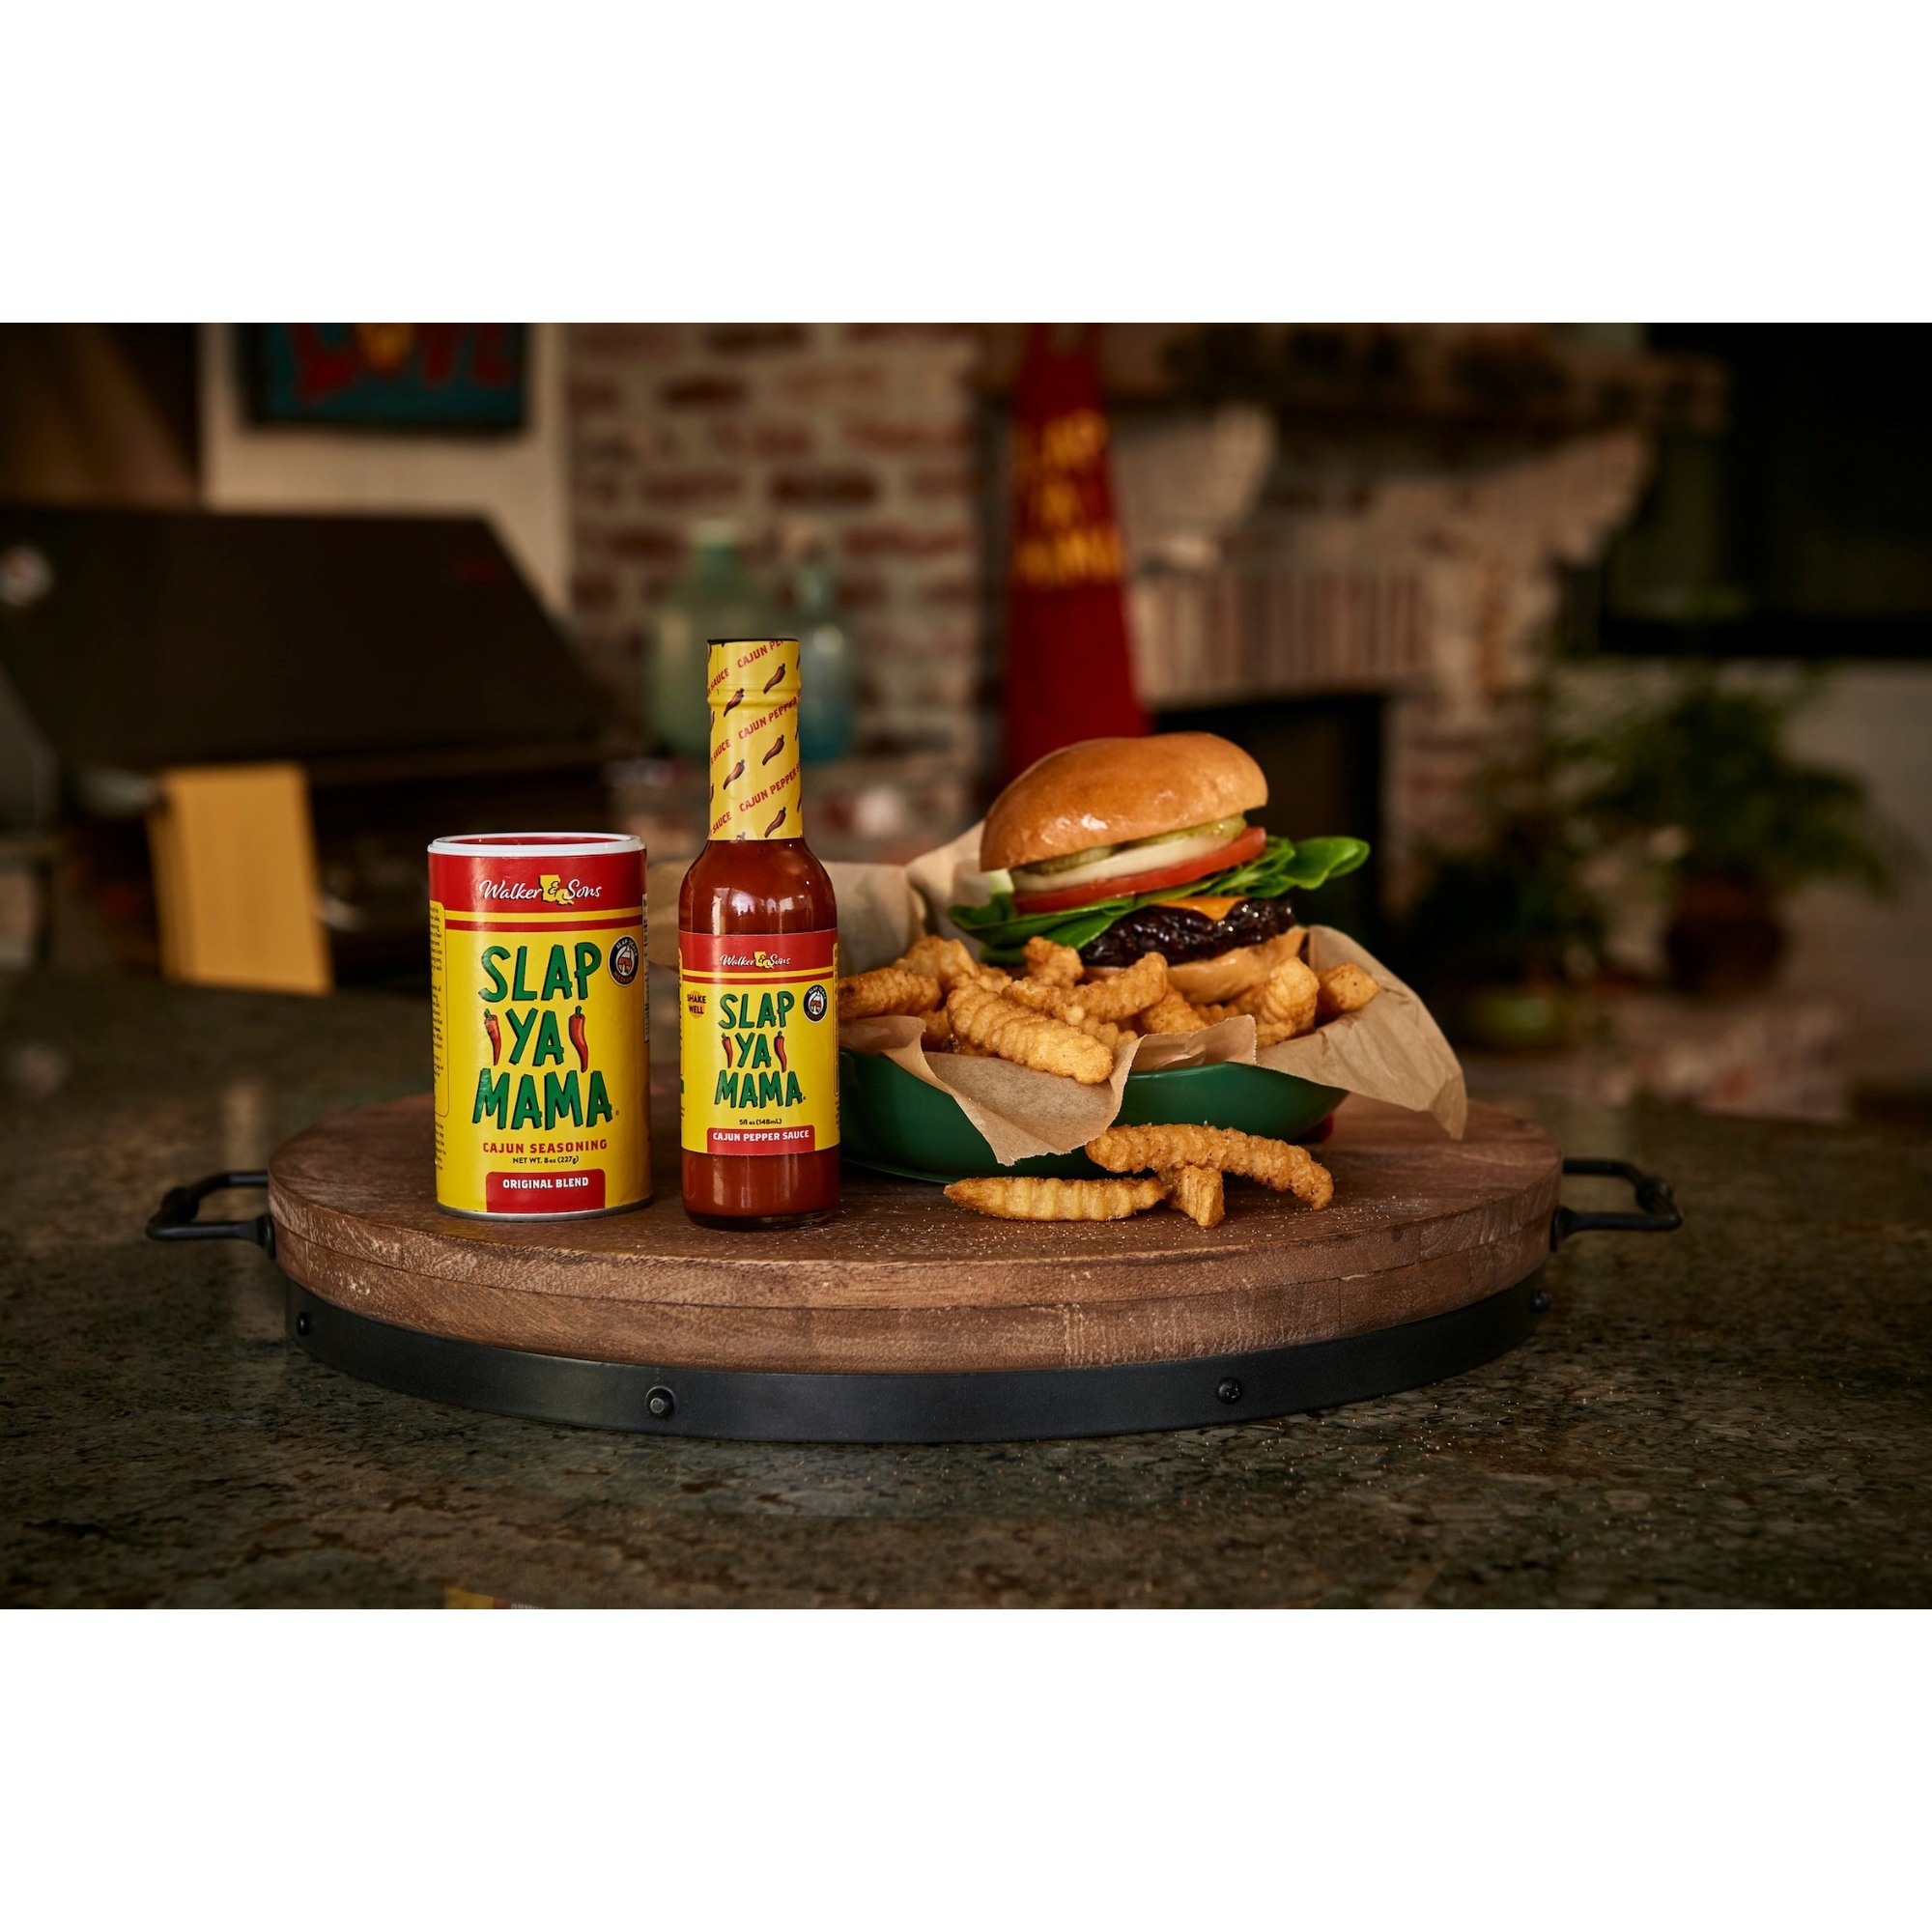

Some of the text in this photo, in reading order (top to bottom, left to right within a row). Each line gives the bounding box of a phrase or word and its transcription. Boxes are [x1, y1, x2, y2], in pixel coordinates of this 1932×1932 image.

[737, 645, 768, 668] CAJUN
[711, 668, 729, 692] SAUCE
[738, 717, 767, 740] CAJUN
[739, 790, 769, 812] CAJUN
[478, 878, 602, 900] Walker & Sons
[720, 953, 755, 967] Walker
[768, 952, 791, 966] Sons
[478, 941, 602, 1003] SLAP
[686, 994, 706, 1005] SHAKE
[689, 1005, 705, 1015] WELL
[718, 990, 795, 1030] SLAP
[505, 1007, 565, 1066] YA
[734, 1032, 772, 1069] YA
[471, 1067, 613, 1130] MAMA
[714, 1069, 804, 1109] MAMA
[483, 1138, 608, 1154] CAJUN SEASONING
[713, 1129, 810, 1142] CAJUN PEPPER SAUCE
[557, 1154, 580, 1165] (227g)
[502, 1177, 589, 1189] ORIGINAL BLEND
